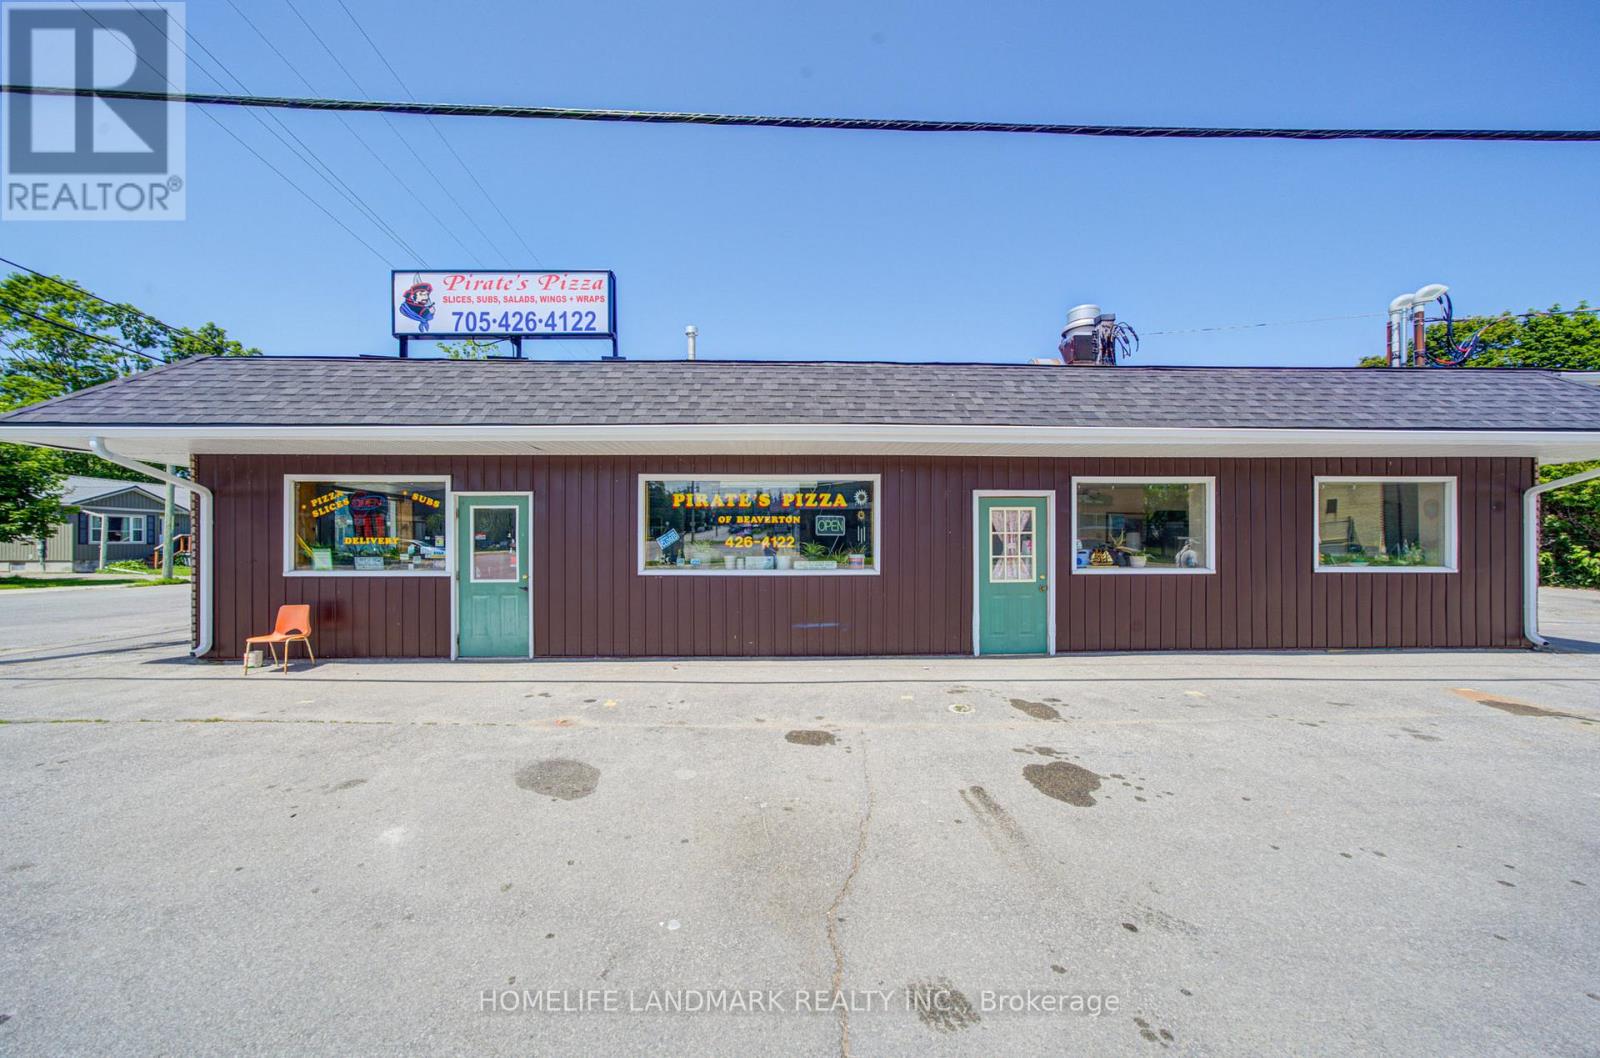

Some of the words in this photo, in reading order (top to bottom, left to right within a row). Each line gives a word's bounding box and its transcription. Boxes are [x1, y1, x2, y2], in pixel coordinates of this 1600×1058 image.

[443, 274, 529, 291] Pirate's
[538, 274, 603, 291] Pizza
[442, 295, 474, 304] SLICES,
[476, 295, 500, 304] SUBS,
[503, 295, 537, 304] SALADS,
[540, 295, 566, 304] WINGS
[576, 295, 606, 303] WRAPS
[310, 490, 344, 507] PIZZA
[412, 492, 440, 508] SUBS
[672, 493, 771, 508] PIRATE'S
[782, 493, 848, 508] PIZZA
[312, 498, 350, 518] SLICES
[718, 516, 732, 524] OF
[736, 516, 800, 524] BEAVERTON
[818, 520, 843, 532] OPEN
[344, 536, 400, 545] DELIVERY
[725, 536, 795, 548] 426-4122
